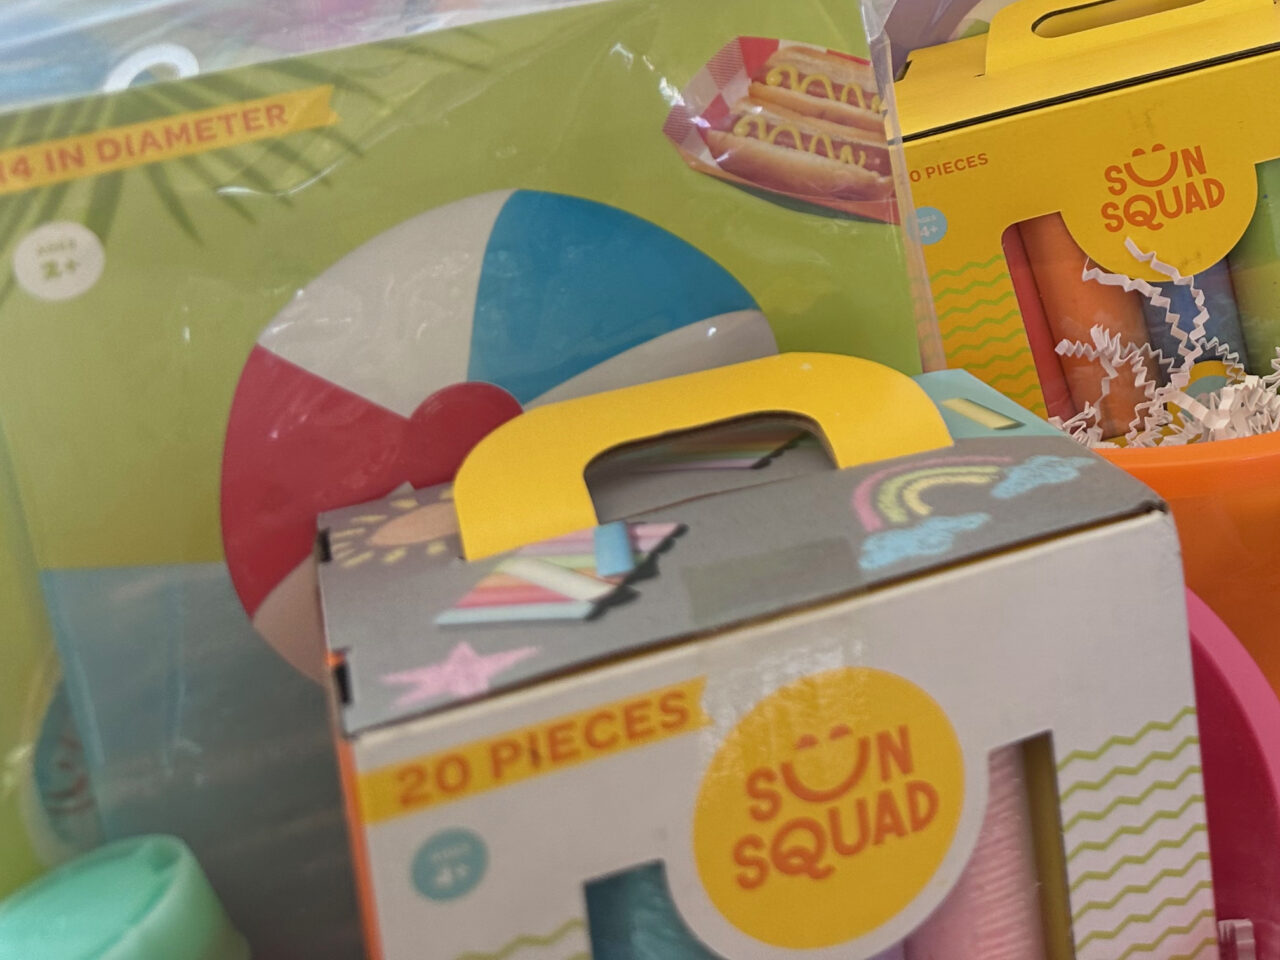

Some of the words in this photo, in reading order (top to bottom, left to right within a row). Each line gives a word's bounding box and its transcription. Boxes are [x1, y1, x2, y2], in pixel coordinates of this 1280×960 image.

[45, 145, 86, 173] IN
[95, 103, 289, 164] DIAMETER
[925, 152, 989, 179] PIECES
[1104, 143, 1207, 196] SUN
[1101, 178, 1225, 233] SQUAD
[396, 753, 474, 810] 20
[491, 690, 691, 783] PIECES
[745, 724, 914, 823] SUN
[733, 779, 940, 892] SQUAD
